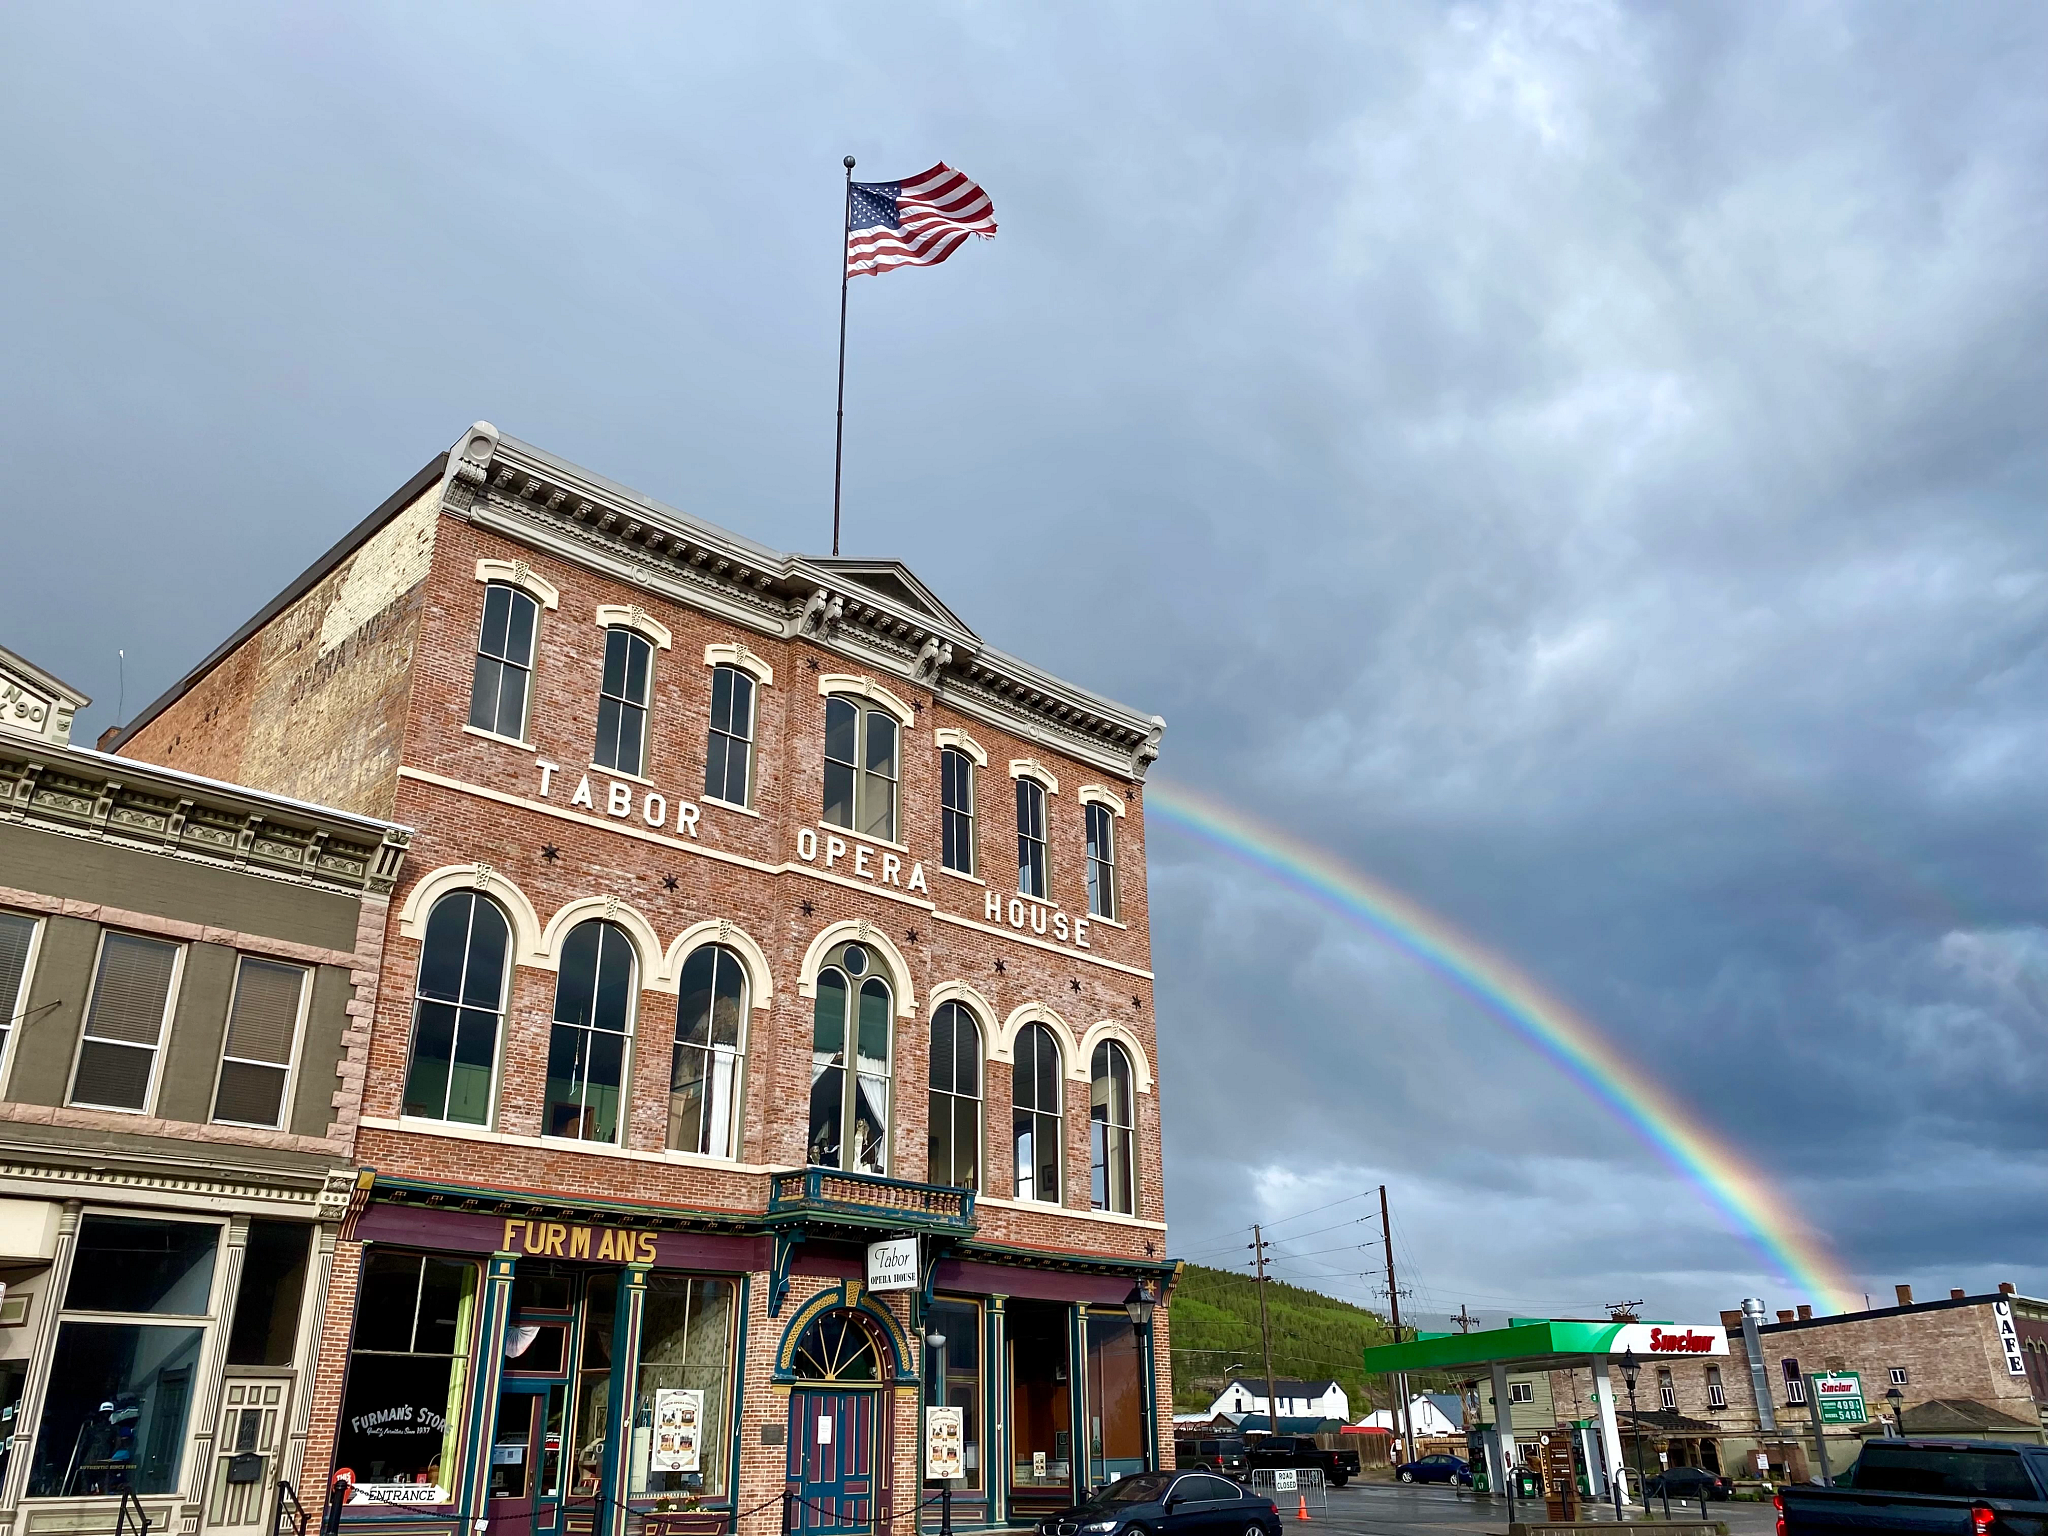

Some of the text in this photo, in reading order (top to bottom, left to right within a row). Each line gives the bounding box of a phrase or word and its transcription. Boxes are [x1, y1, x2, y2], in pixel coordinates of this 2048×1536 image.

[535, 759, 700, 838] TABOR
[797, 828, 928, 895] OPERA
[985, 891, 1090, 949] HOUSE
[502, 1219, 658, 1263] FURMANS
[874, 1247, 910, 1268] Tabor
[871, 1272, 916, 1285] OPERA HOUSE
[1650, 1328, 1715, 1353] Sinclair
[1996, 1301, 2023, 1371] CAFE
[1821, 1382, 1853, 1393] Sinclair
[351, 1404, 413, 1433] FURMAN'S
[337, 1472, 351, 1481] THIS
[1277, 1481, 1296, 1489] CLOSED
[368, 1490, 436, 1501] ENTRANCE
